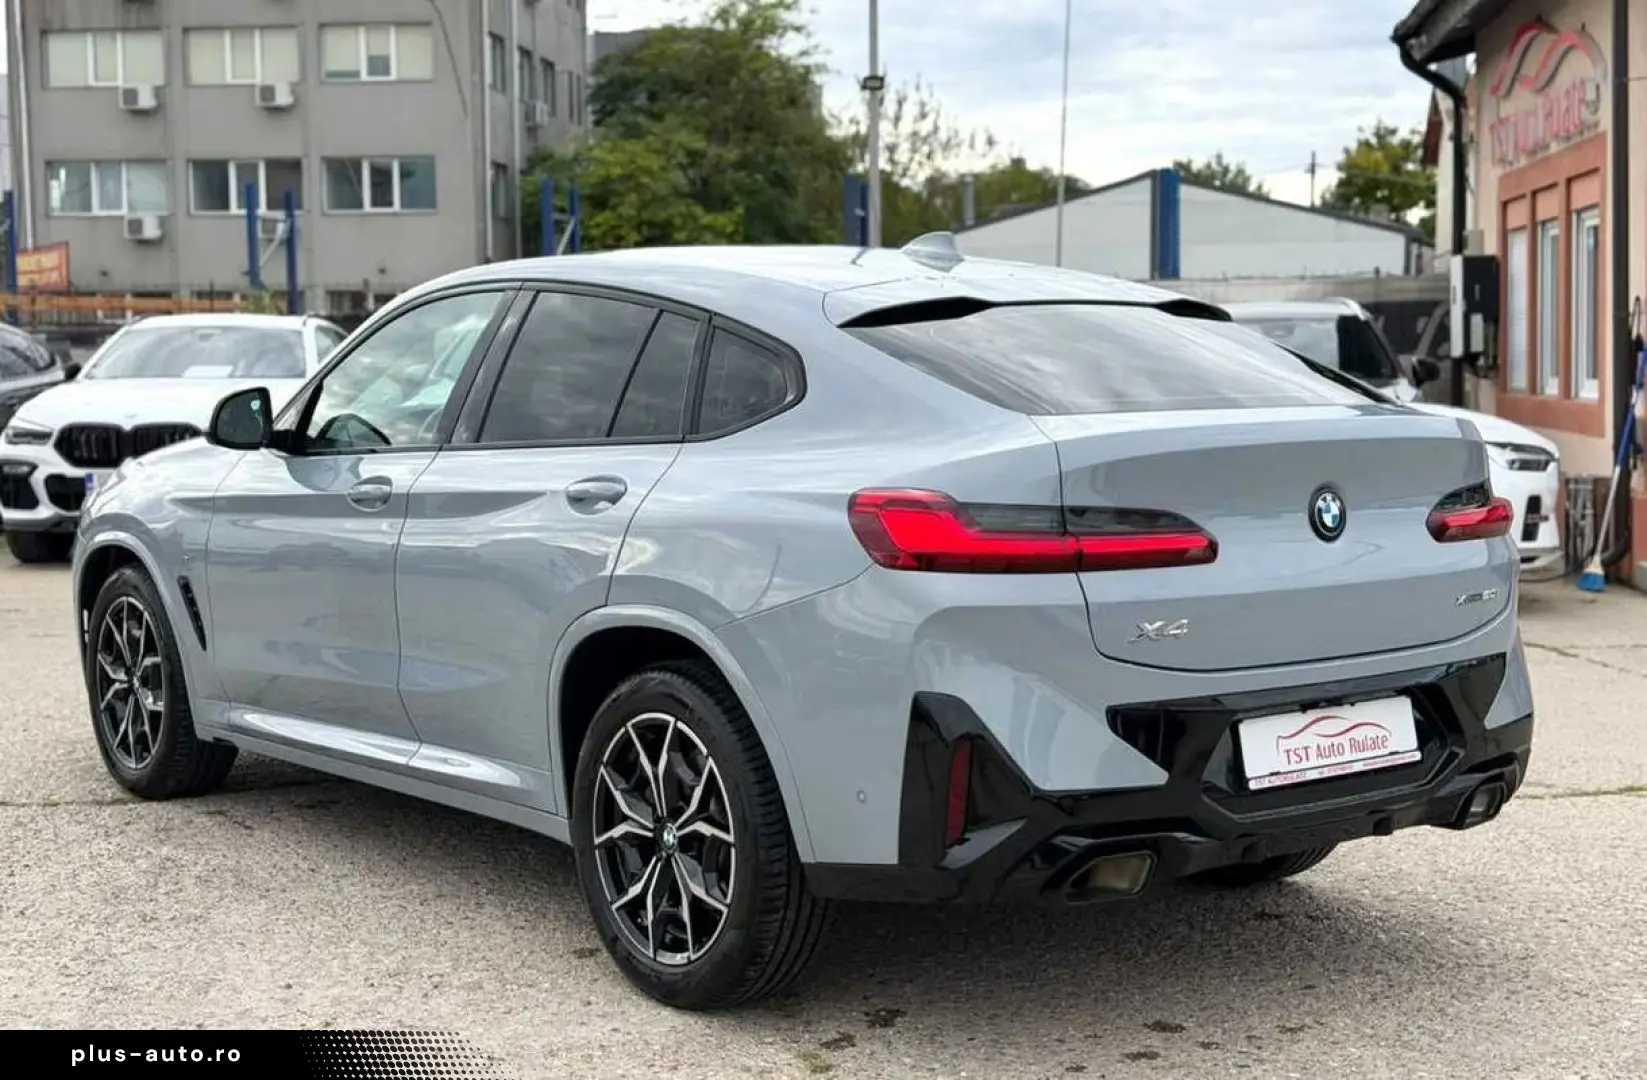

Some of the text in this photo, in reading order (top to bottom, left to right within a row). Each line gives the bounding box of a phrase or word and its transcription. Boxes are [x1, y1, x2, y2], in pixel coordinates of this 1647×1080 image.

[1128, 618, 1188, 643] X4
[1283, 734, 1389, 765] TST Auto Rulate
